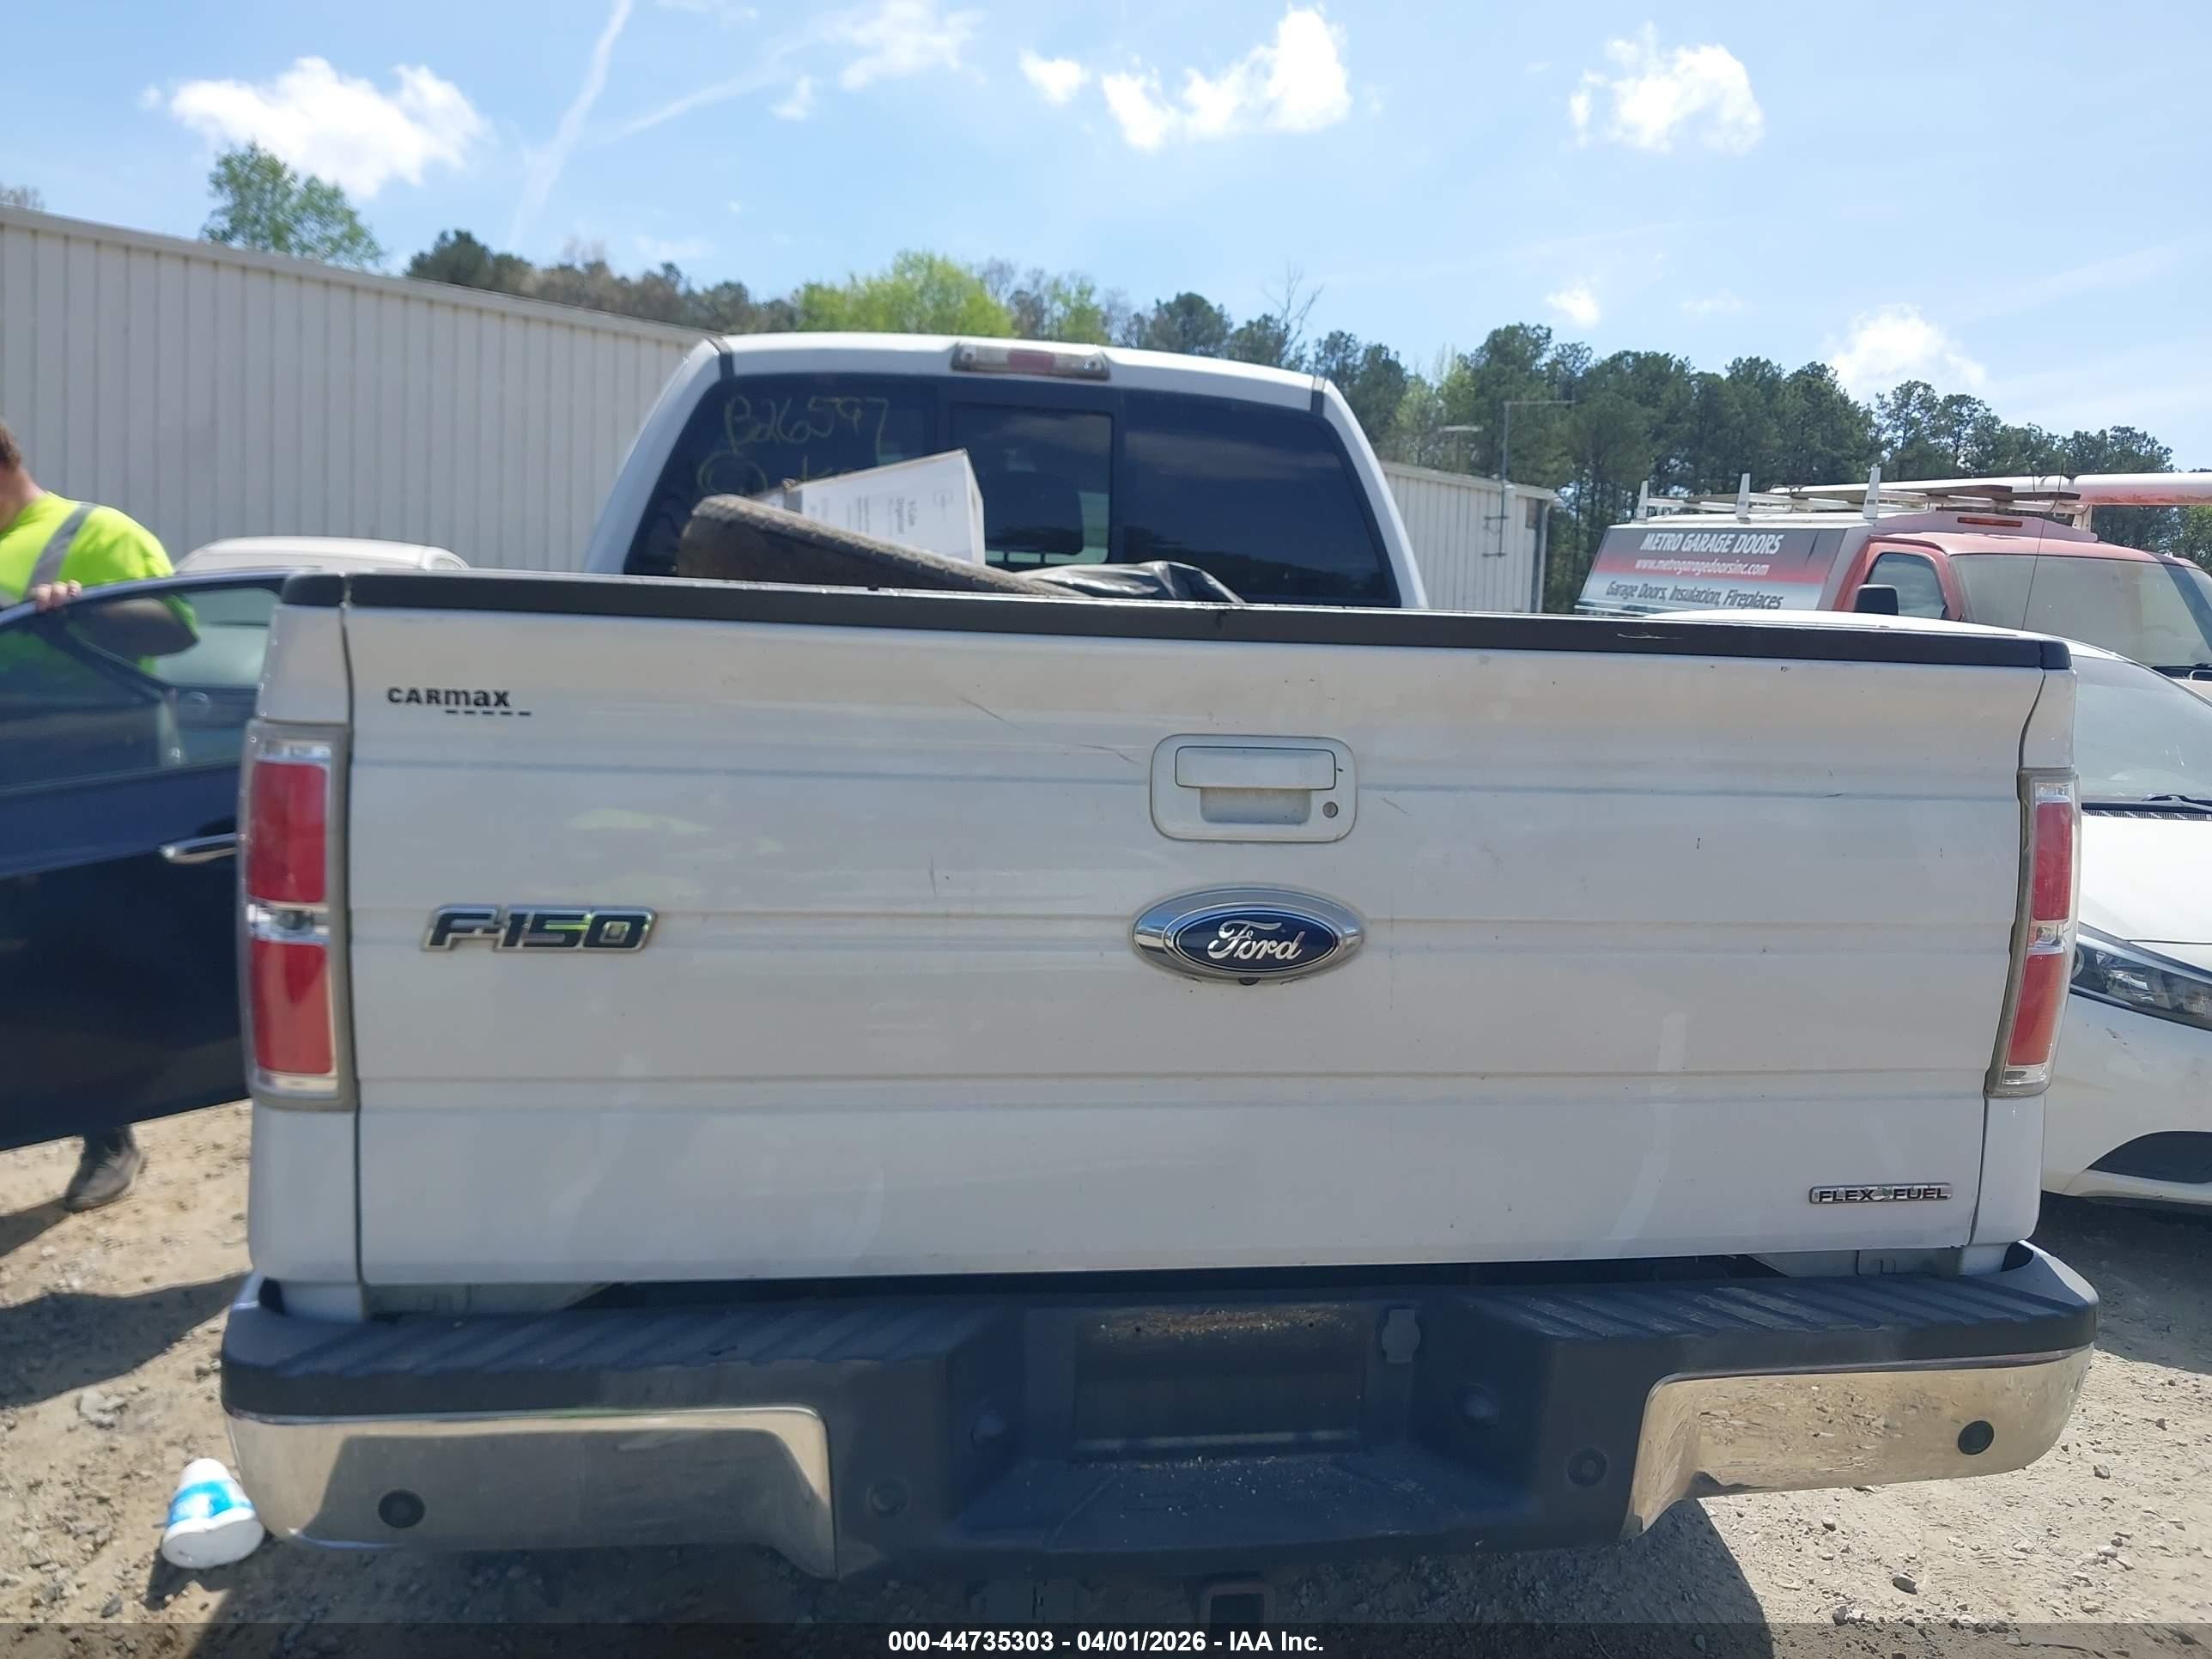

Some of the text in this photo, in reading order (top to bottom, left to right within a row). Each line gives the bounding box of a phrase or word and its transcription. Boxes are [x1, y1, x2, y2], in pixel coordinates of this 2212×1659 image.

[1640, 532, 1784, 555] METRO GARAGE DOORS
[1635, 558, 1770, 576] www.metrogaragedoorsinc.com
[1606, 580, 1784, 609] Garage Doors, Insulation, Fireplaces
[422, 903, 657, 952] F-150
[1207, 919, 1306, 960] Ford
[1819, 1188, 1948, 1202] FLEX FUEL
